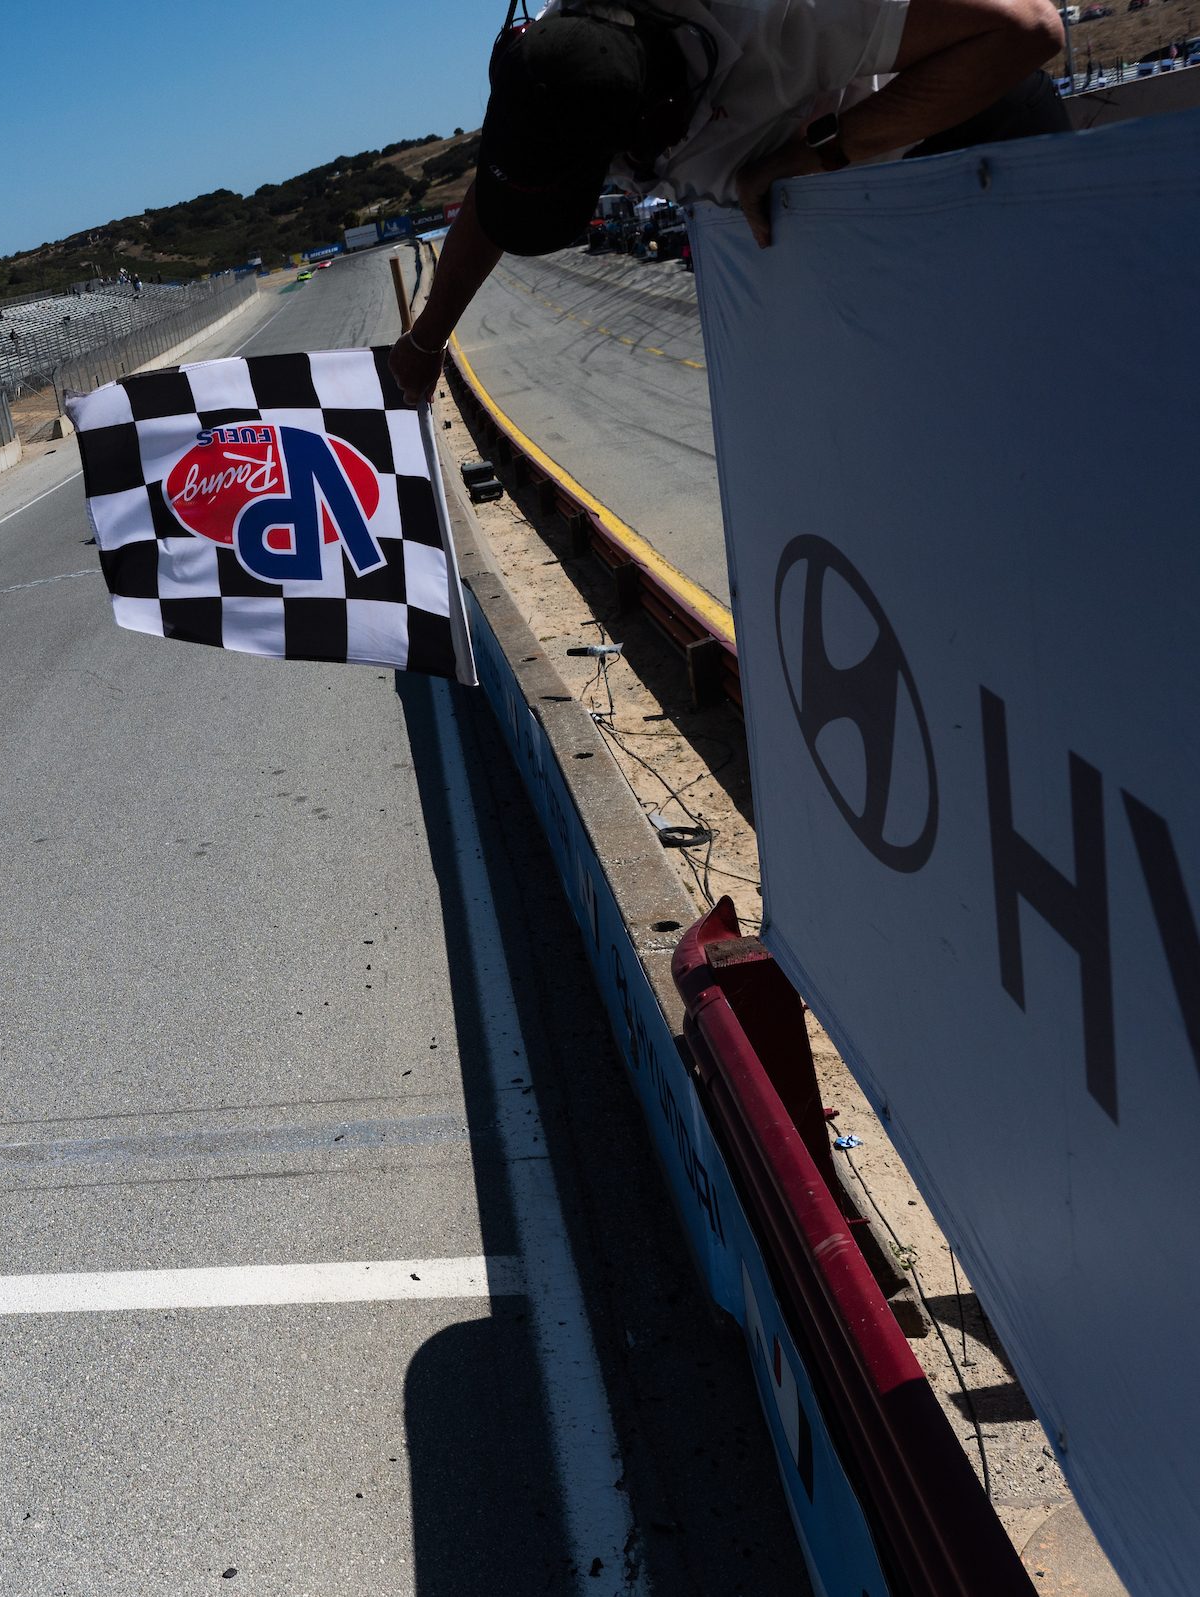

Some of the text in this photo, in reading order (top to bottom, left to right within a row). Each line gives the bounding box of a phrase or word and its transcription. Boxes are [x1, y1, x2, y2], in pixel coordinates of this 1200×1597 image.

[172, 446, 278, 505] Racing
[196, 427, 272, 446] FUELS
[233, 426, 387, 584] VP
[633, 996, 727, 1250] HYUNDAI
